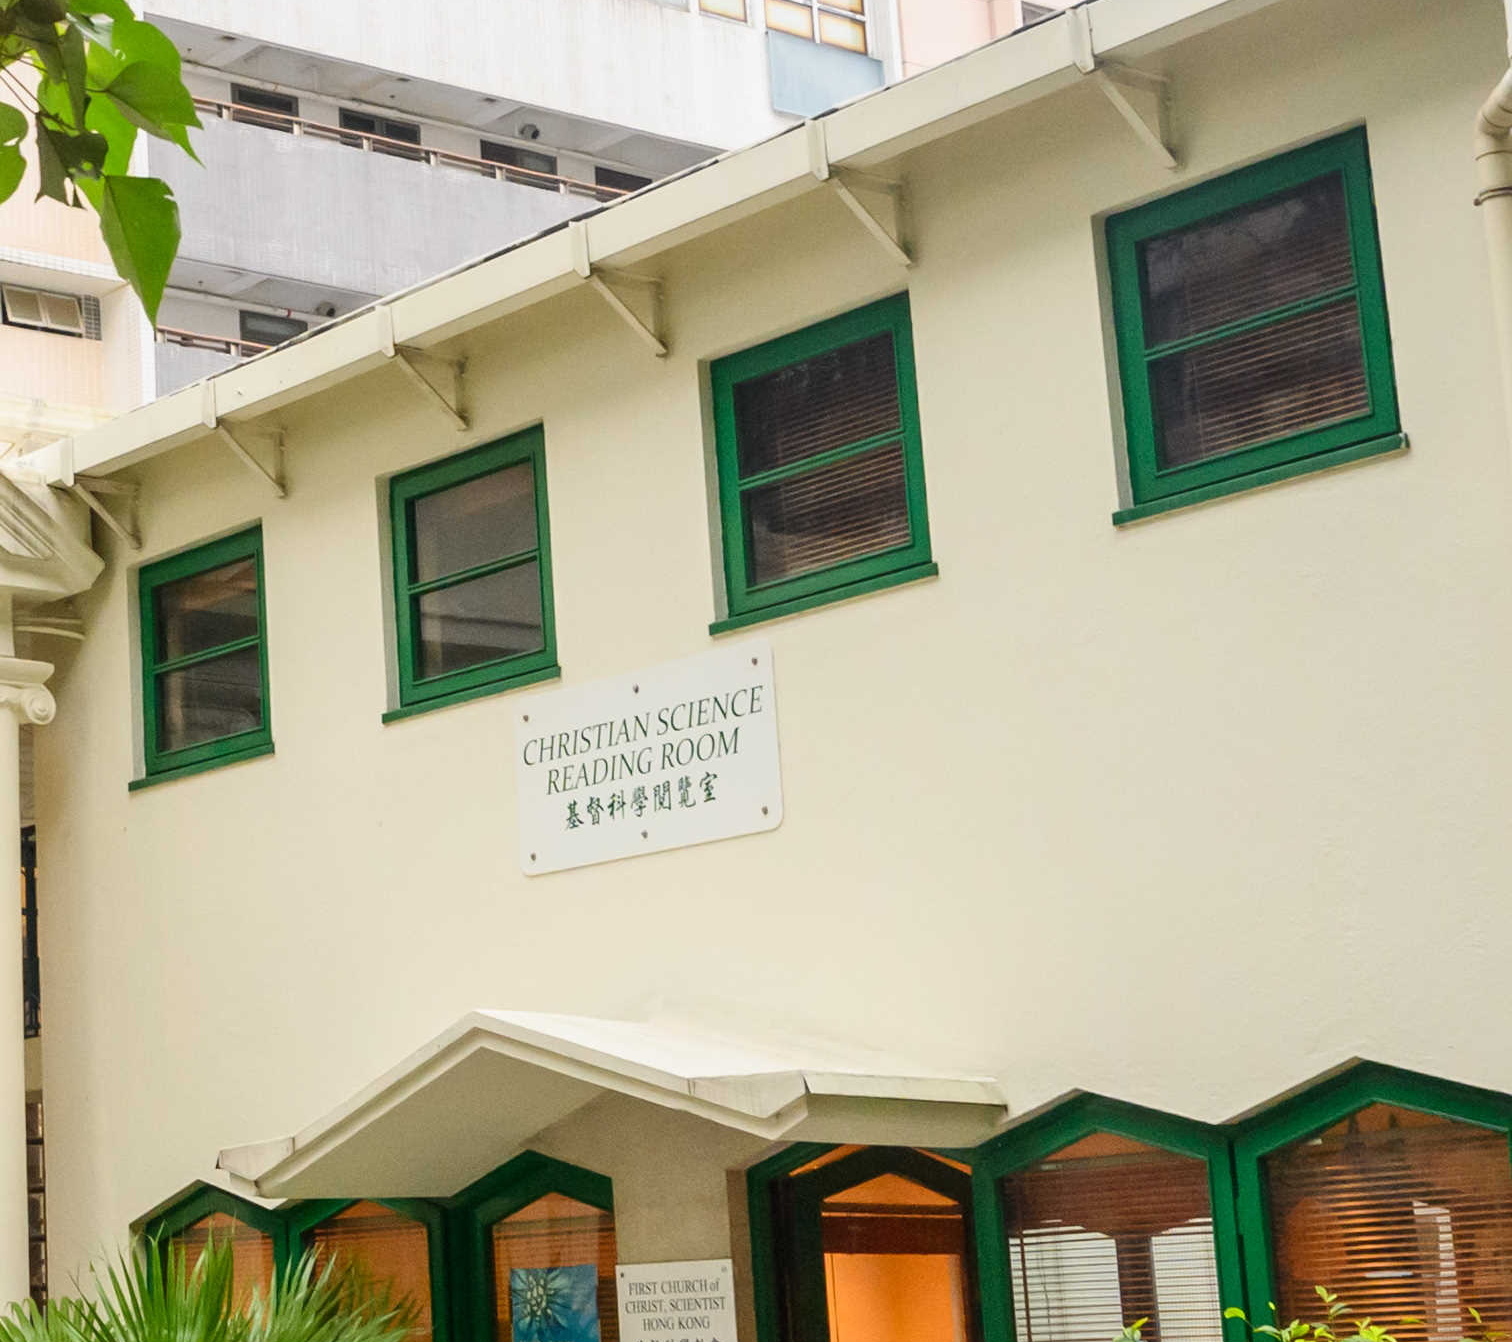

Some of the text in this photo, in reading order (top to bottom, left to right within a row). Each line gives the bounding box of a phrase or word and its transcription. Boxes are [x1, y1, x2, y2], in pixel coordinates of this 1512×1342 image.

[523, 685, 764, 766] CHRISTIAN SCIENCE
[546, 727, 741, 795] READING ROOM
[629, 1278, 720, 1296] FIRST CHURCH of
[670, 1297, 726, 1311] SCIENTIST
[643, 1316, 710, 1331] HONG KONG
